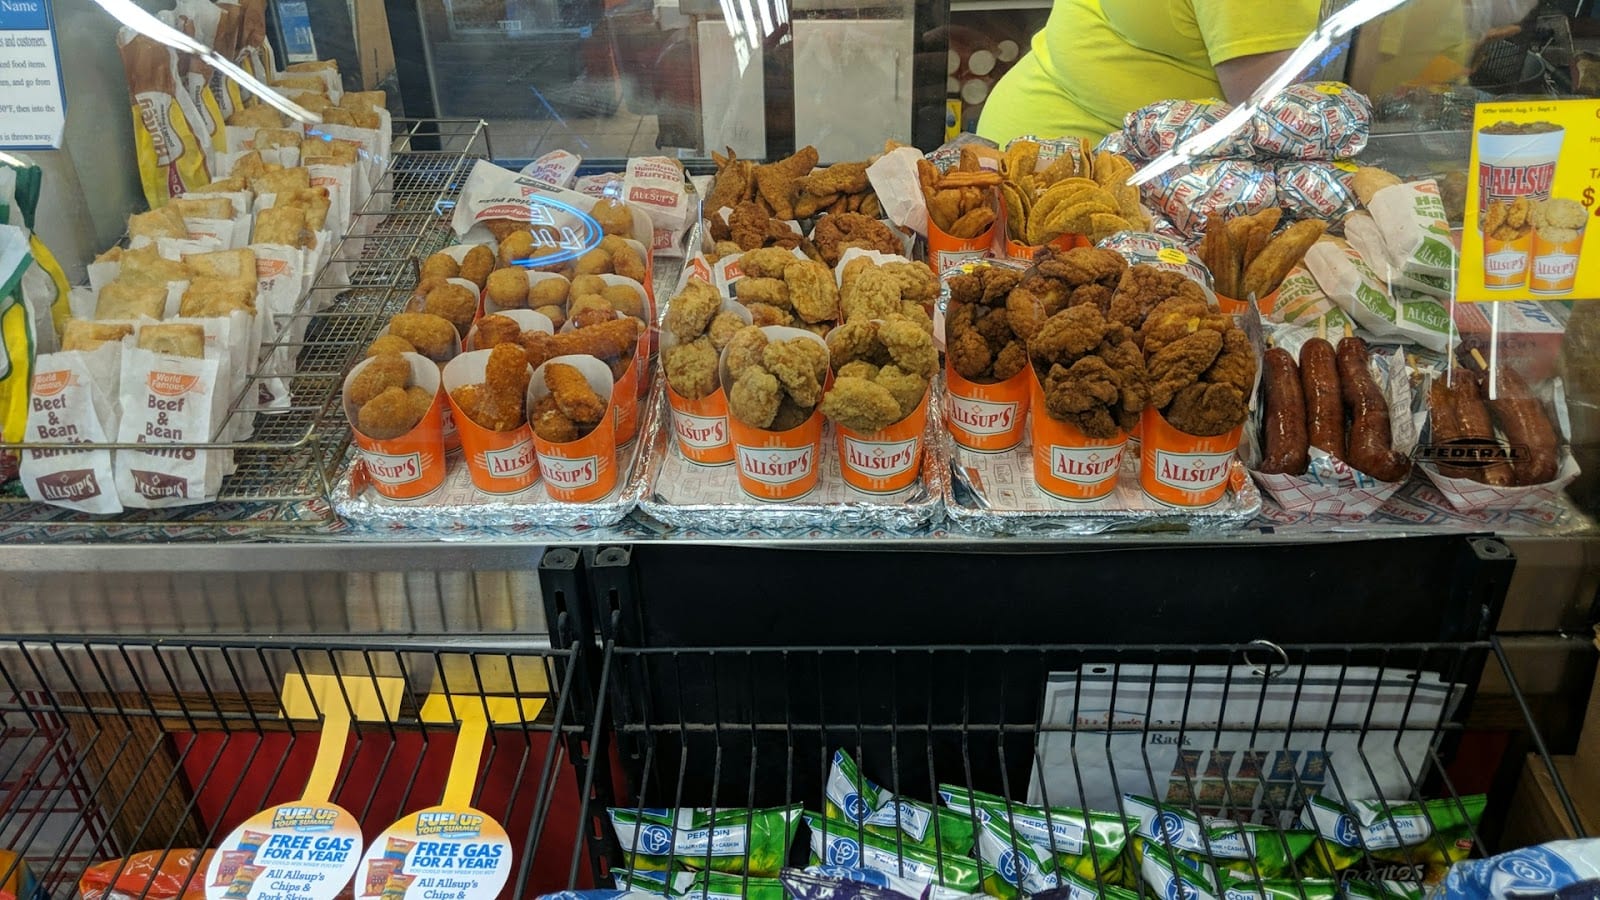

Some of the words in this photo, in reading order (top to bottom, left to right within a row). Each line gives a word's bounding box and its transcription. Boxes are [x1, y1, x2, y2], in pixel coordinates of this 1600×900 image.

[1, 0, 38, 12] Name
[12, 60, 26, 68] food
[25, 80, 34, 88] go
[16, 104, 30, 112] then
[632, 190, 675, 204] ALLSUP'S
[1407, 307, 1449, 327] ALLSUP
[156, 373, 182, 383] World
[151, 380, 186, 391] Famous
[33, 394, 67, 412] Beef
[148, 394, 185, 412] Beef
[48, 412, 60, 426] &
[157, 412, 169, 426] &
[950, 403, 1011, 428] ALLSUP'S
[37, 423, 78, 440] Bean
[145, 421, 182, 440] Bean
[675, 420, 723, 442] ALLSUP'S
[493, 445, 537, 473] ALLSUP
[848, 443, 913, 470] ALLSUP'S
[1423, 448, 1520, 458] FEDERAL
[366, 458, 416, 478] ALLSUP'S
[744, 450, 809, 477] ALLSUP'S
[1057, 452, 1123, 476] ALLSUP'S
[1160, 455, 1230, 483] ALLSUP'S
[541, 461, 593, 483] ALLSUP'S
[43, 473, 96, 499] ALLSUP'S
[275, 807, 313, 821] FUEL
[315, 808, 338, 821] UP
[418, 813, 456, 827] FUEL
[459, 814, 483, 827] UP
[273, 819, 297, 828] YOUR
[417, 826, 441, 834] YOUR
[268, 834, 314, 849] FREE
[314, 836, 355, 851] GAS
[263, 848, 292, 860] FOR
[292, 849, 303, 860] A
[308, 850, 349, 862] YEAR!
[415, 842, 461, 857] FREE
[463, 844, 504, 858] GAS
[411, 856, 441, 867] FOR
[441, 857, 453, 868] A
[458, 858, 499, 869] YEAR!
[265, 869, 283, 879] All
[283, 870, 325, 882] Allsup's
[270, 881, 300, 893] Chips
[302, 883, 312, 892] &
[417, 878, 435, 888] All
[435, 878, 478, 890] Allsup's
[257, 892, 283, 900] Pork
[423, 890, 455, 900] Chips
[456, 890, 466, 900] &
